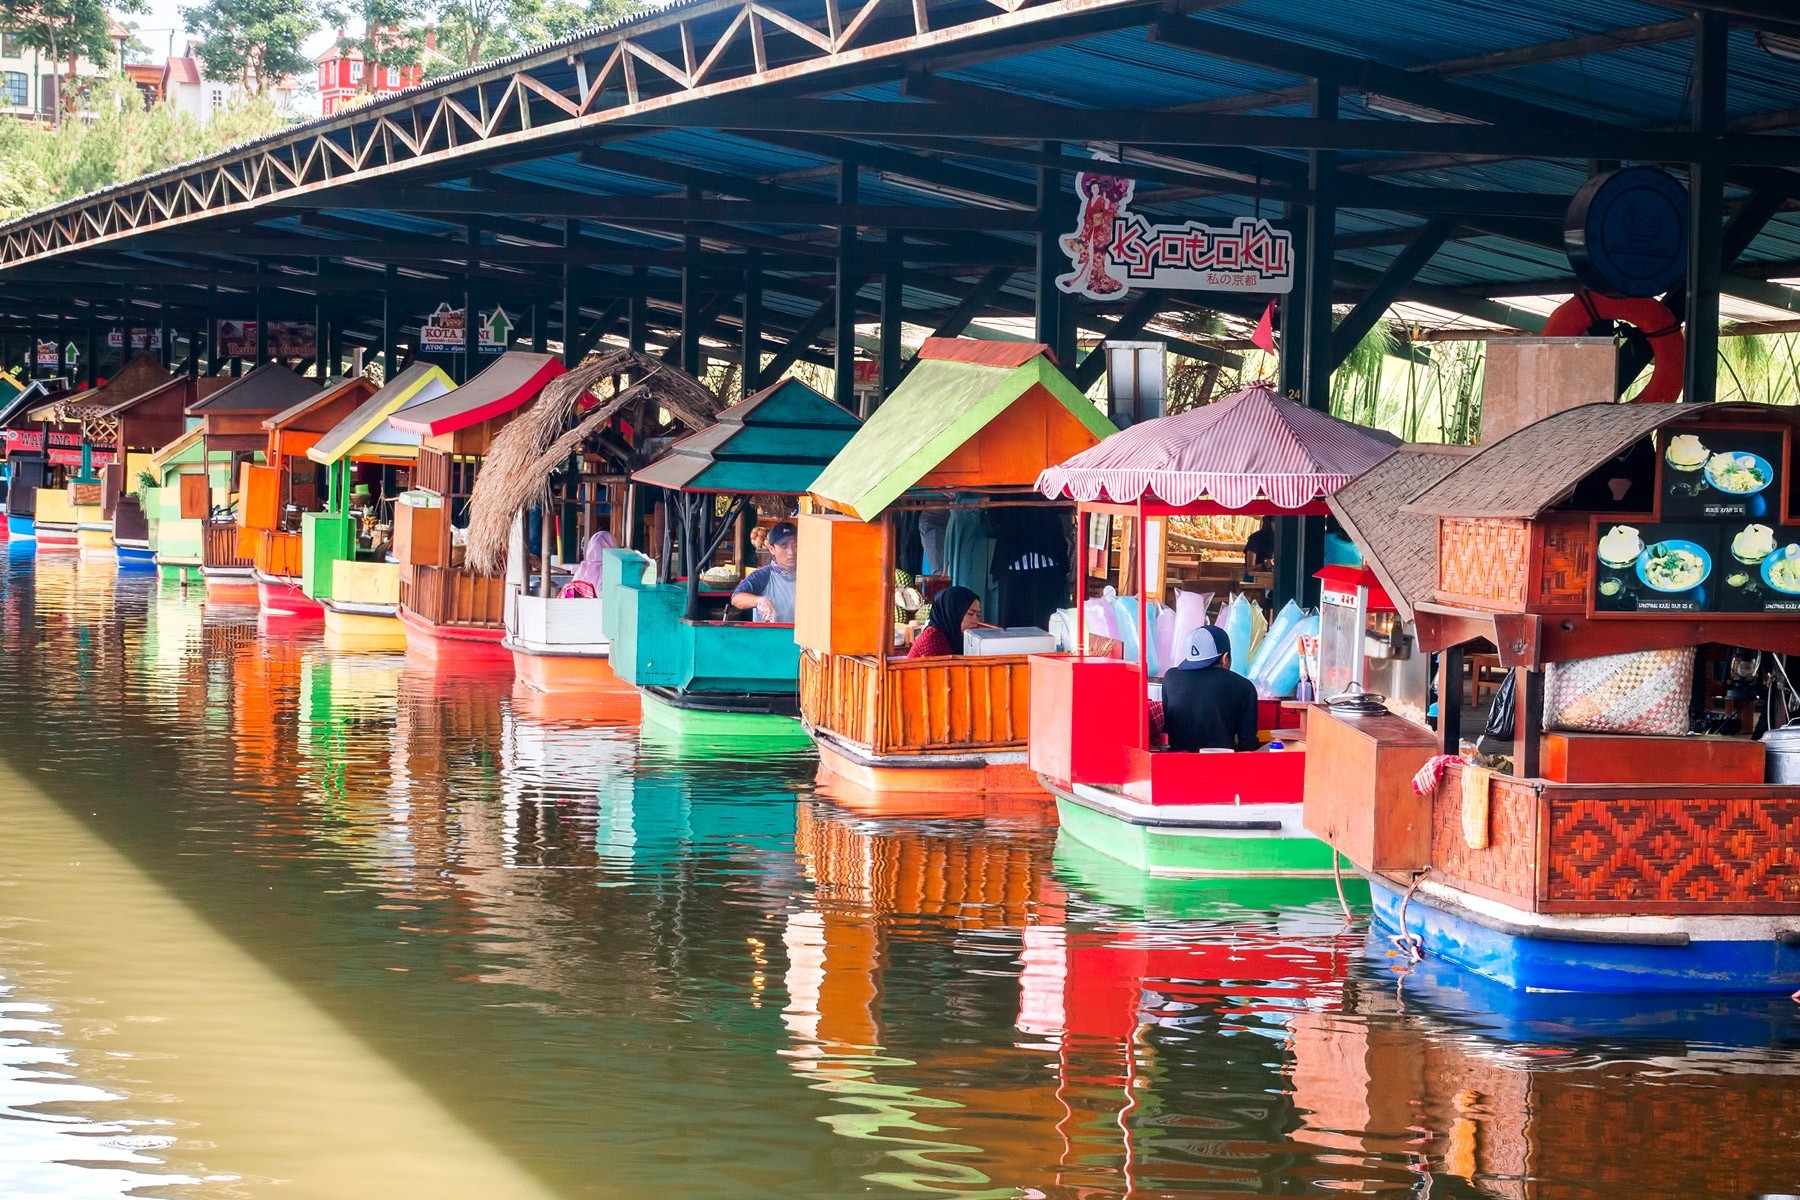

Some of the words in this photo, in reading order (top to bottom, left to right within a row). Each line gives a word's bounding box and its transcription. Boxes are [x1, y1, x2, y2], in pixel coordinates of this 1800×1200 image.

[1206, 273, 1258, 287] 私の京都
[425, 328, 458, 339] KOTA
[746, 388, 756, 396] 21
[1288, 388, 1301, 400] 24
